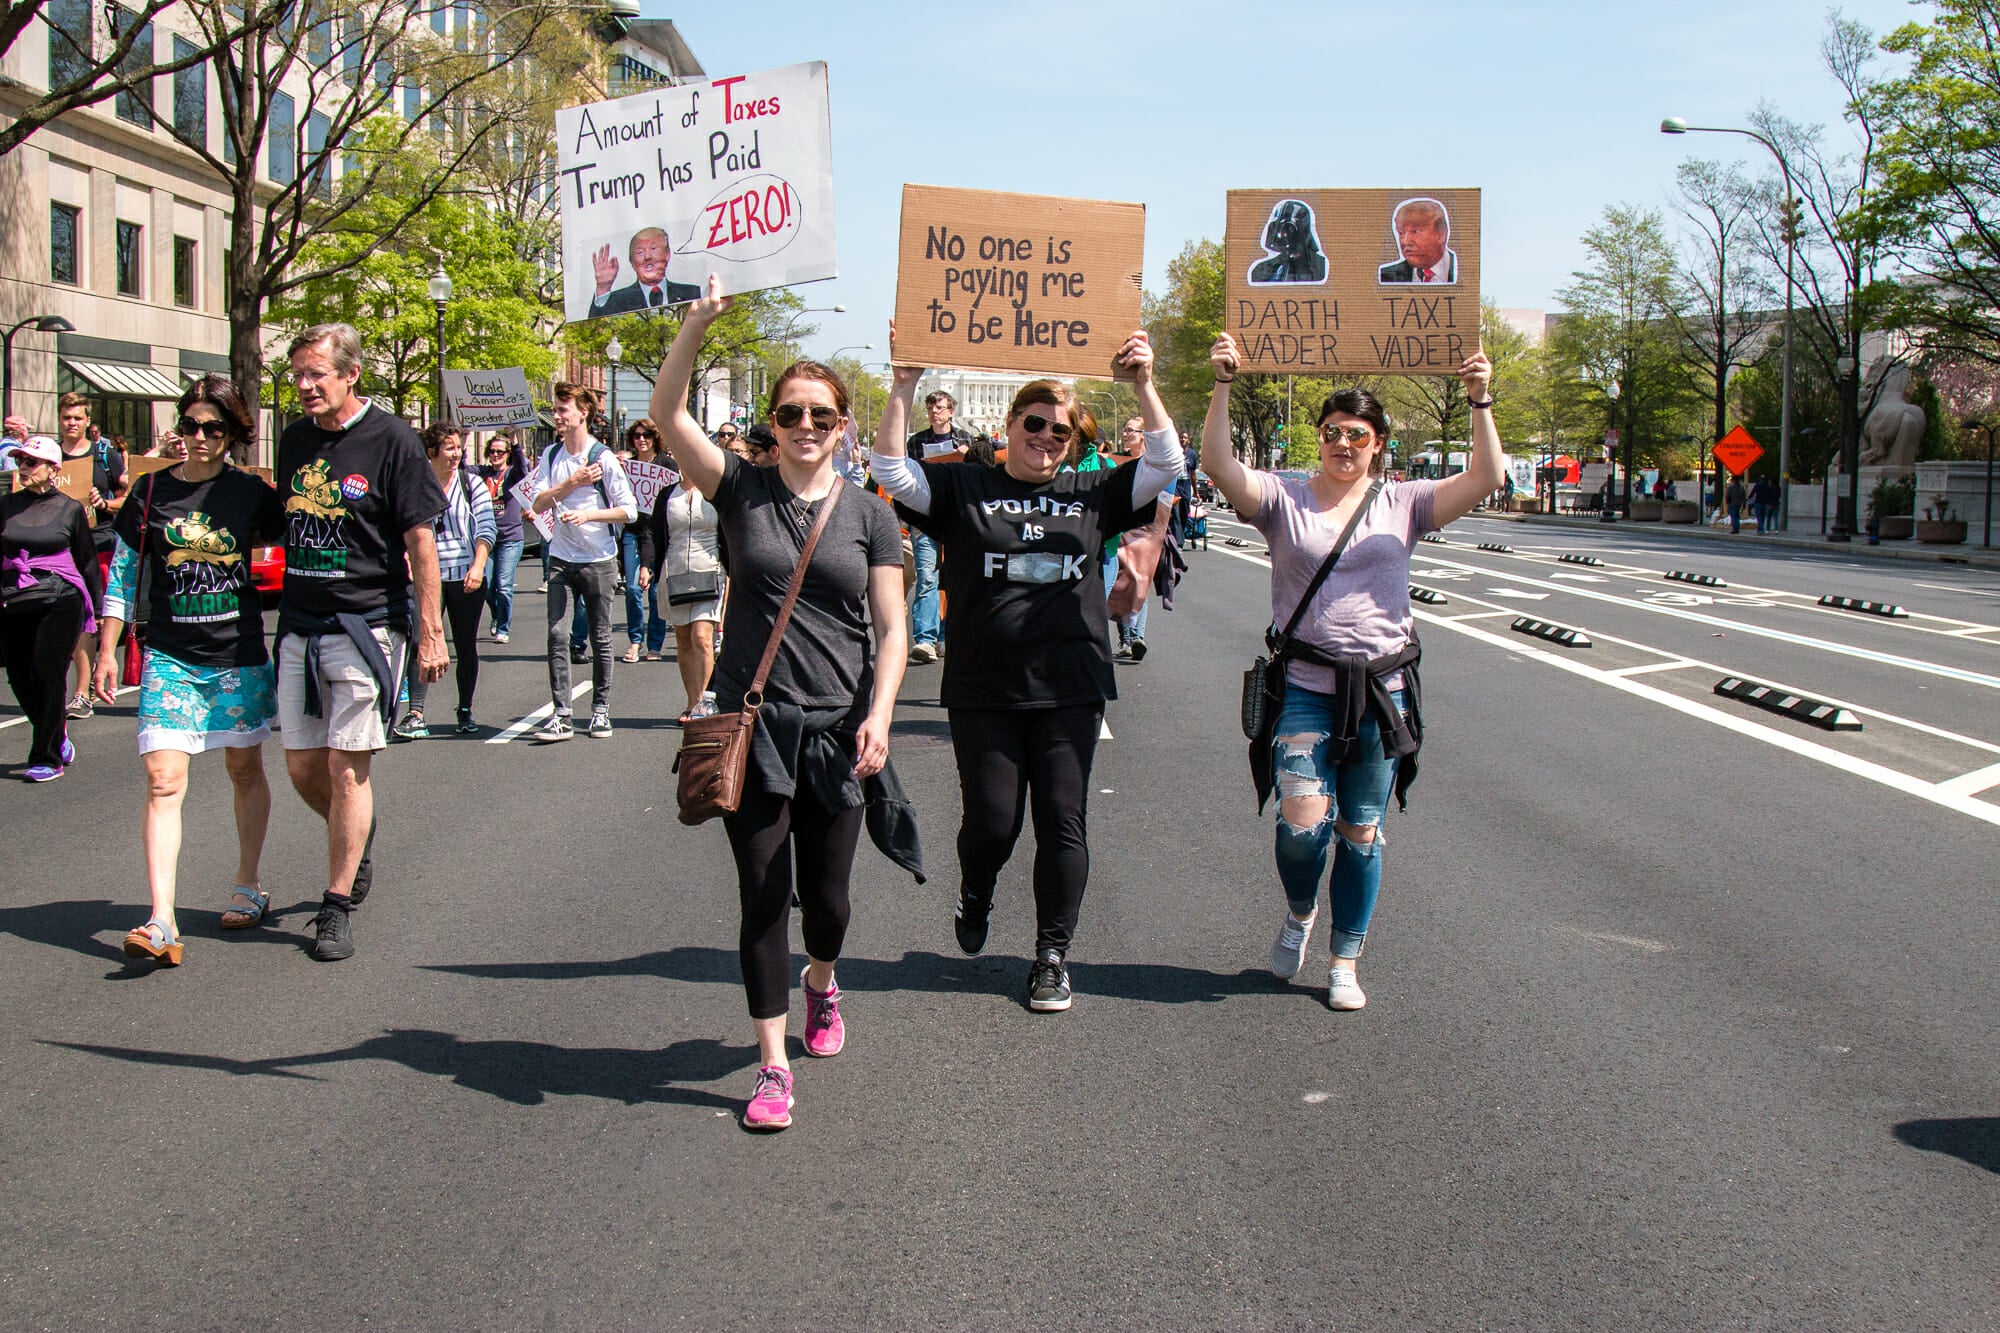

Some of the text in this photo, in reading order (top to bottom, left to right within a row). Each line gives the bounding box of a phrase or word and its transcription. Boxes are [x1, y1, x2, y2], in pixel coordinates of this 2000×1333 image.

[576, 75, 781, 154] Amount of Taxes
[562, 129, 762, 209] Trump has Paid
[706, 181, 793, 249] ZERO!
[925, 226, 1072, 264] No one is
[945, 266, 1085, 309] paying me
[927, 298, 1089, 348] to be Here
[1238, 300, 1340, 331] DARTH
[1382, 296, 1457, 330] TAXI
[1240, 333, 1340, 366] VADER
[1370, 333, 1466, 368] VADER
[464, 375, 504, 394] Donald
[470, 393, 525, 405] America's
[456, 403, 535, 427] Dependent Child!
[346, 478, 367, 490] DUMP
[622, 460, 675, 485] RELEASE
[342, 485, 365, 497] TRUMP
[982, 496, 1084, 518] POLITE
[285, 510, 347, 549] TAX
[1022, 522, 1045, 541] AS
[166, 561, 241, 595] TAX
[984, 552, 1087, 580] FK
[169, 592, 240, 616] MARCH
